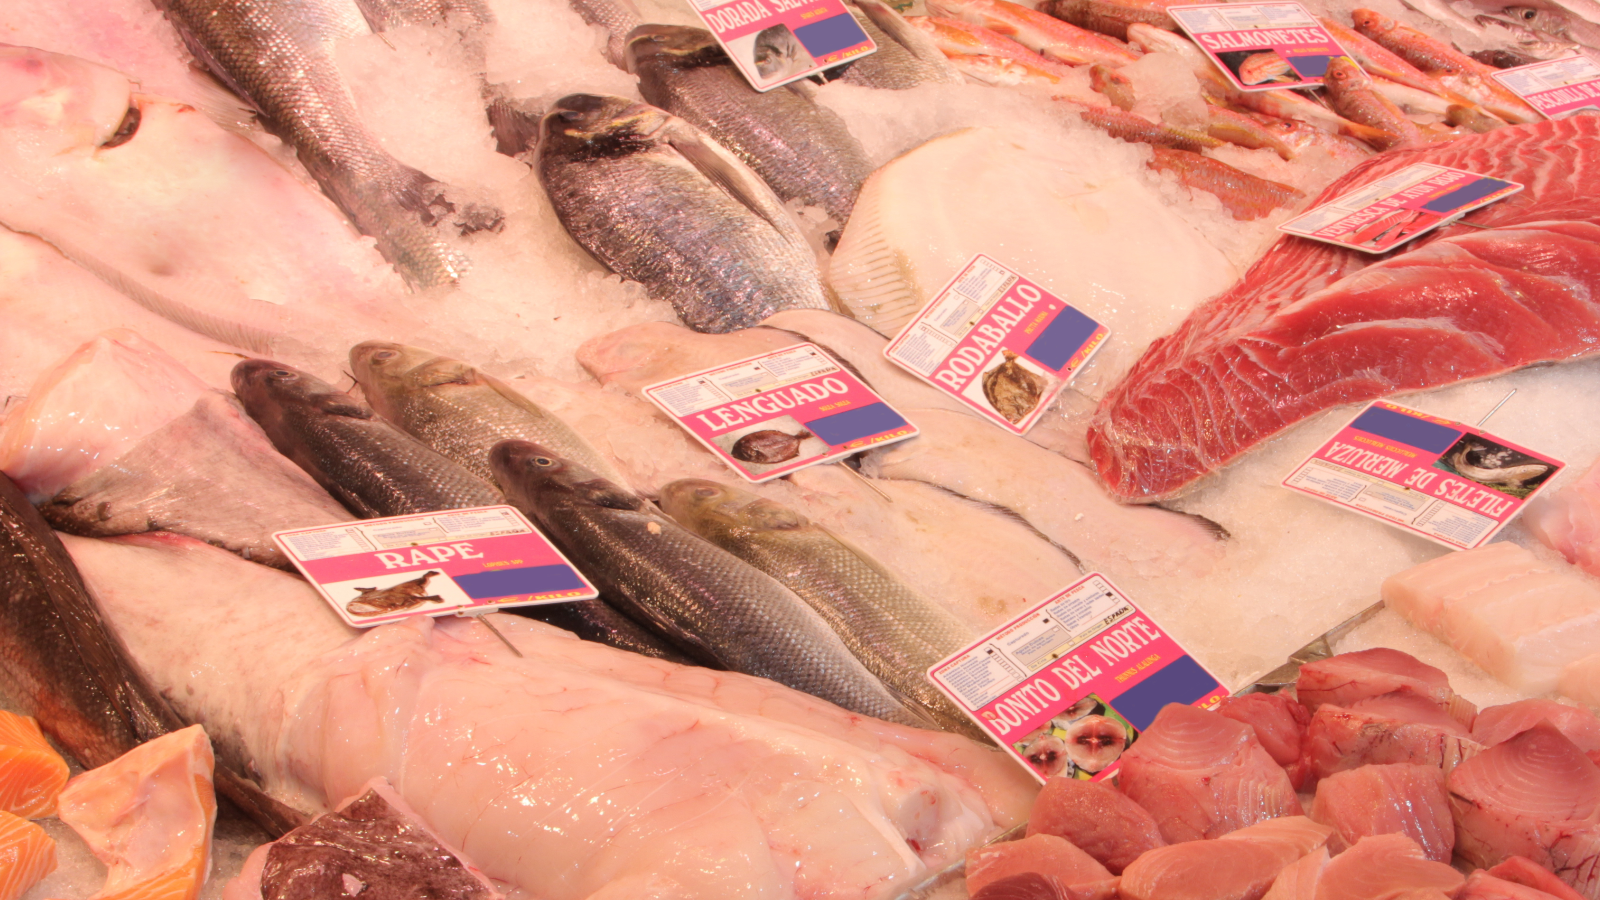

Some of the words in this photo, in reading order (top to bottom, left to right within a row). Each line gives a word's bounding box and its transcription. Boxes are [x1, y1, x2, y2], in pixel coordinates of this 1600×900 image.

[705, 1, 772, 33] DORADA
[1201, 28, 1329, 49] SALMONETES
[1314, 201, 1388, 238] VENTRESCA
[1385, 193, 1407, 207] DE
[1428, 171, 1466, 187] ROJO
[935, 284, 1042, 391] RODABALLO
[697, 377, 849, 431] LENGUADO
[1323, 441, 1409, 478] MERLUZA
[1404, 467, 1438, 490] DE
[1435, 477, 1514, 518] FILETES
[373, 542, 484, 570] RAPE
[982, 677, 1061, 735] BONITO
[1051, 654, 1102, 690] DEL
[1090, 616, 1162, 667] NORTE
